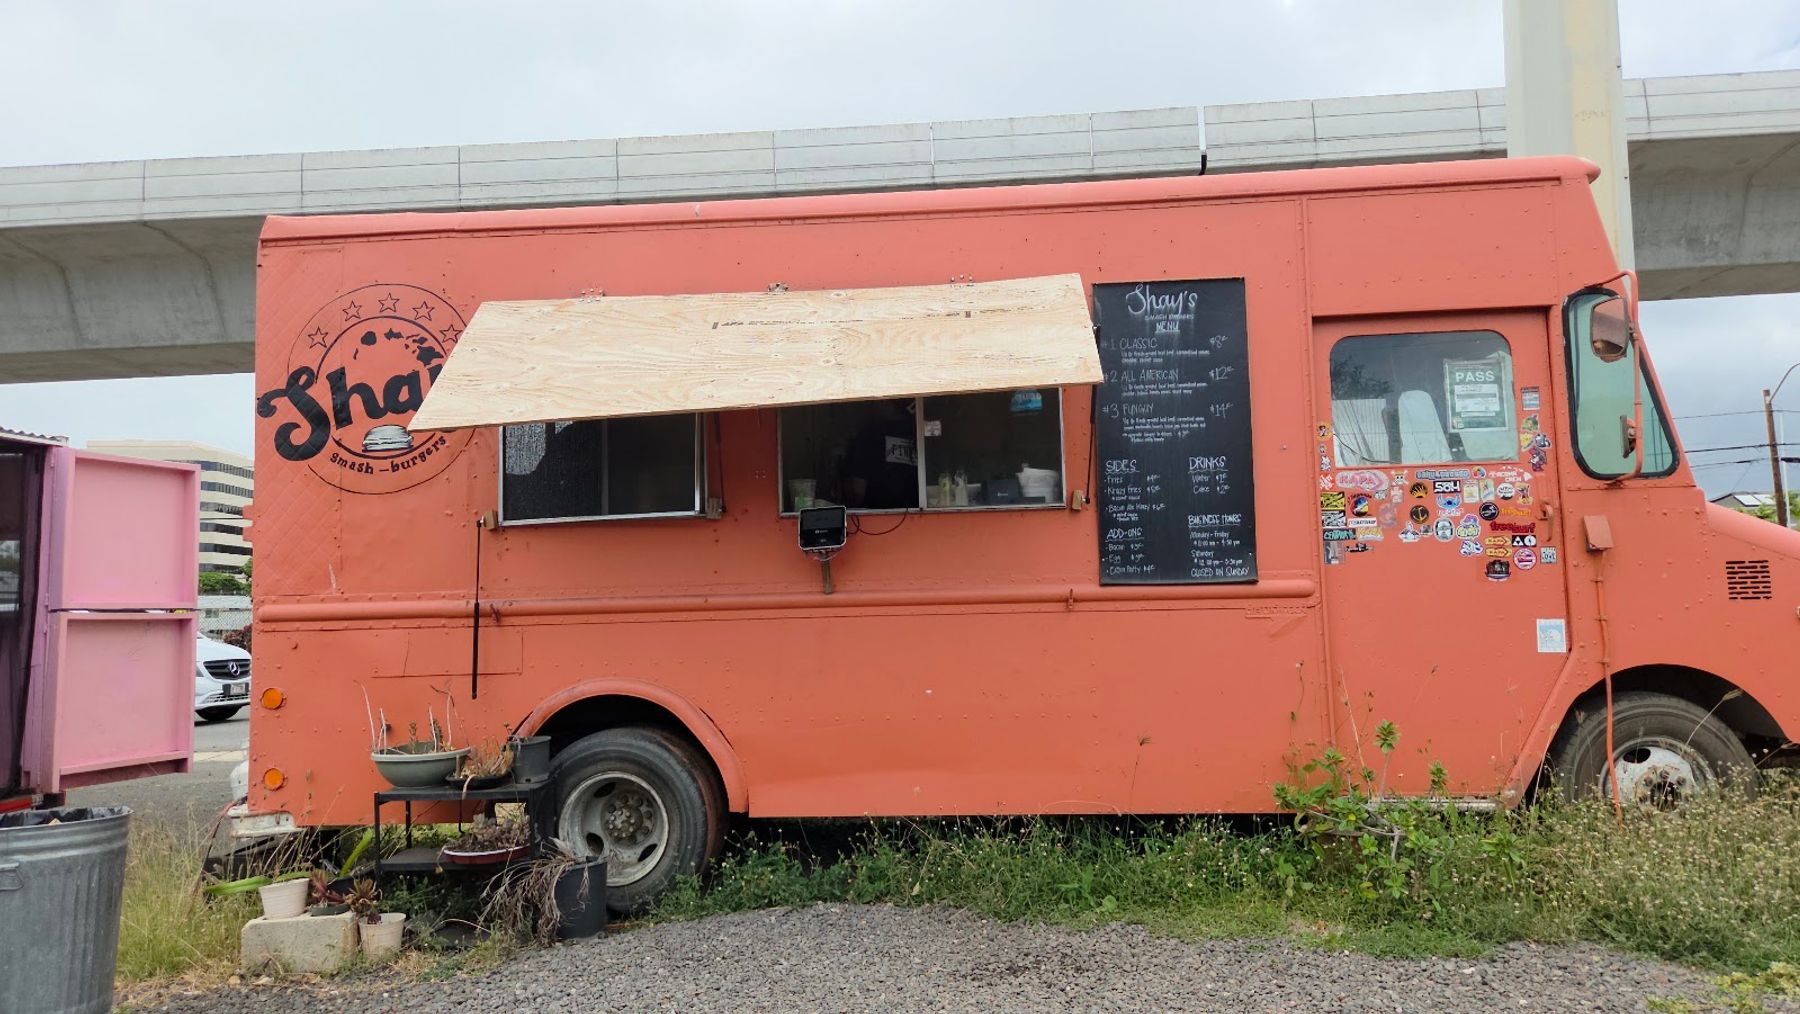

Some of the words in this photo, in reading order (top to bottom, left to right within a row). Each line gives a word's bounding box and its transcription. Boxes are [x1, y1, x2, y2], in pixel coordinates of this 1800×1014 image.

[1125, 283, 1198, 315] Shay's
[1156, 321, 1180, 332] MENU
[1119, 337, 1158, 350] CLASSIC
[1455, 370, 1496, 383] PASS
[1105, 459, 1137, 472] SIDES
[1188, 456, 1226, 470] DRINKS
[1106, 528, 1143, 539] ADD-ONS
